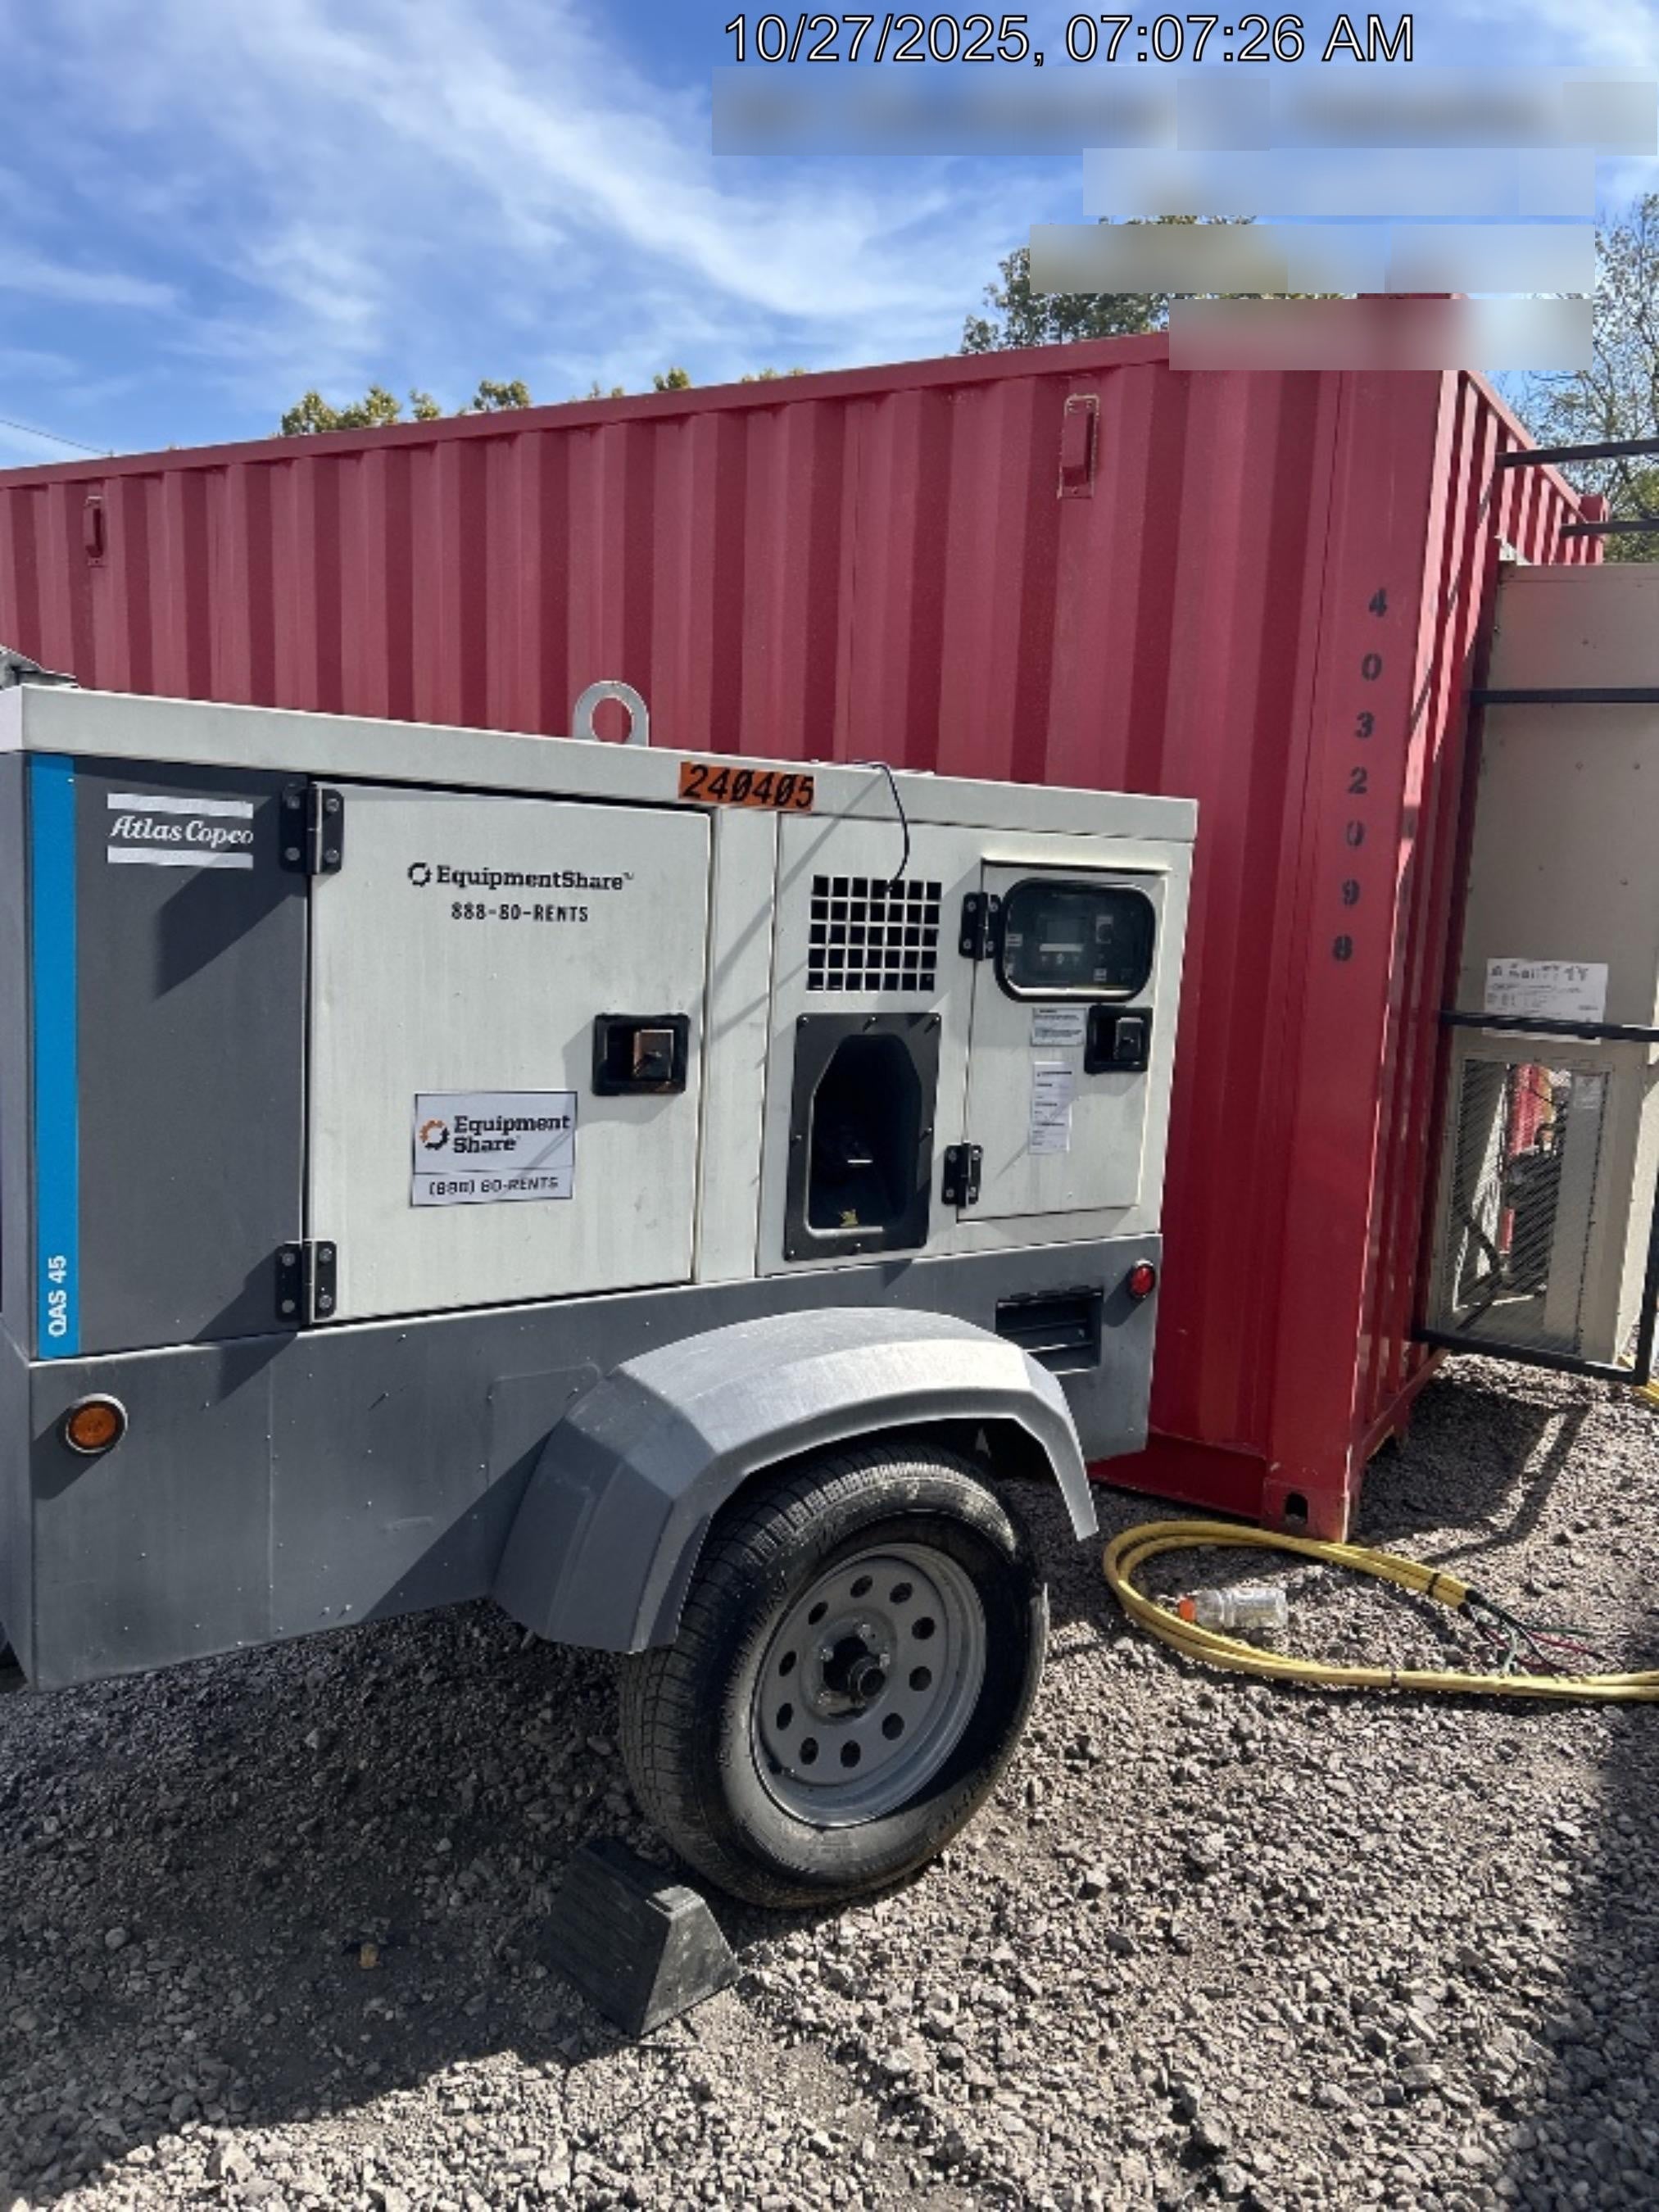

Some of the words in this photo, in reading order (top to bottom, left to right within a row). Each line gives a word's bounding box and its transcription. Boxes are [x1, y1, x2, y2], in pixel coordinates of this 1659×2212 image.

[682, 764, 814, 809] 240405
[109, 814, 182, 841] Atlas
[185, 819, 254, 850] Copco
[451, 900, 589, 923] 888-80-RENTS
[454, 1114, 571, 1136] Equipment
[453, 1136, 517, 1154] Share
[47, 1254, 68, 1285] 45
[47, 1289, 68, 1338] QAS
